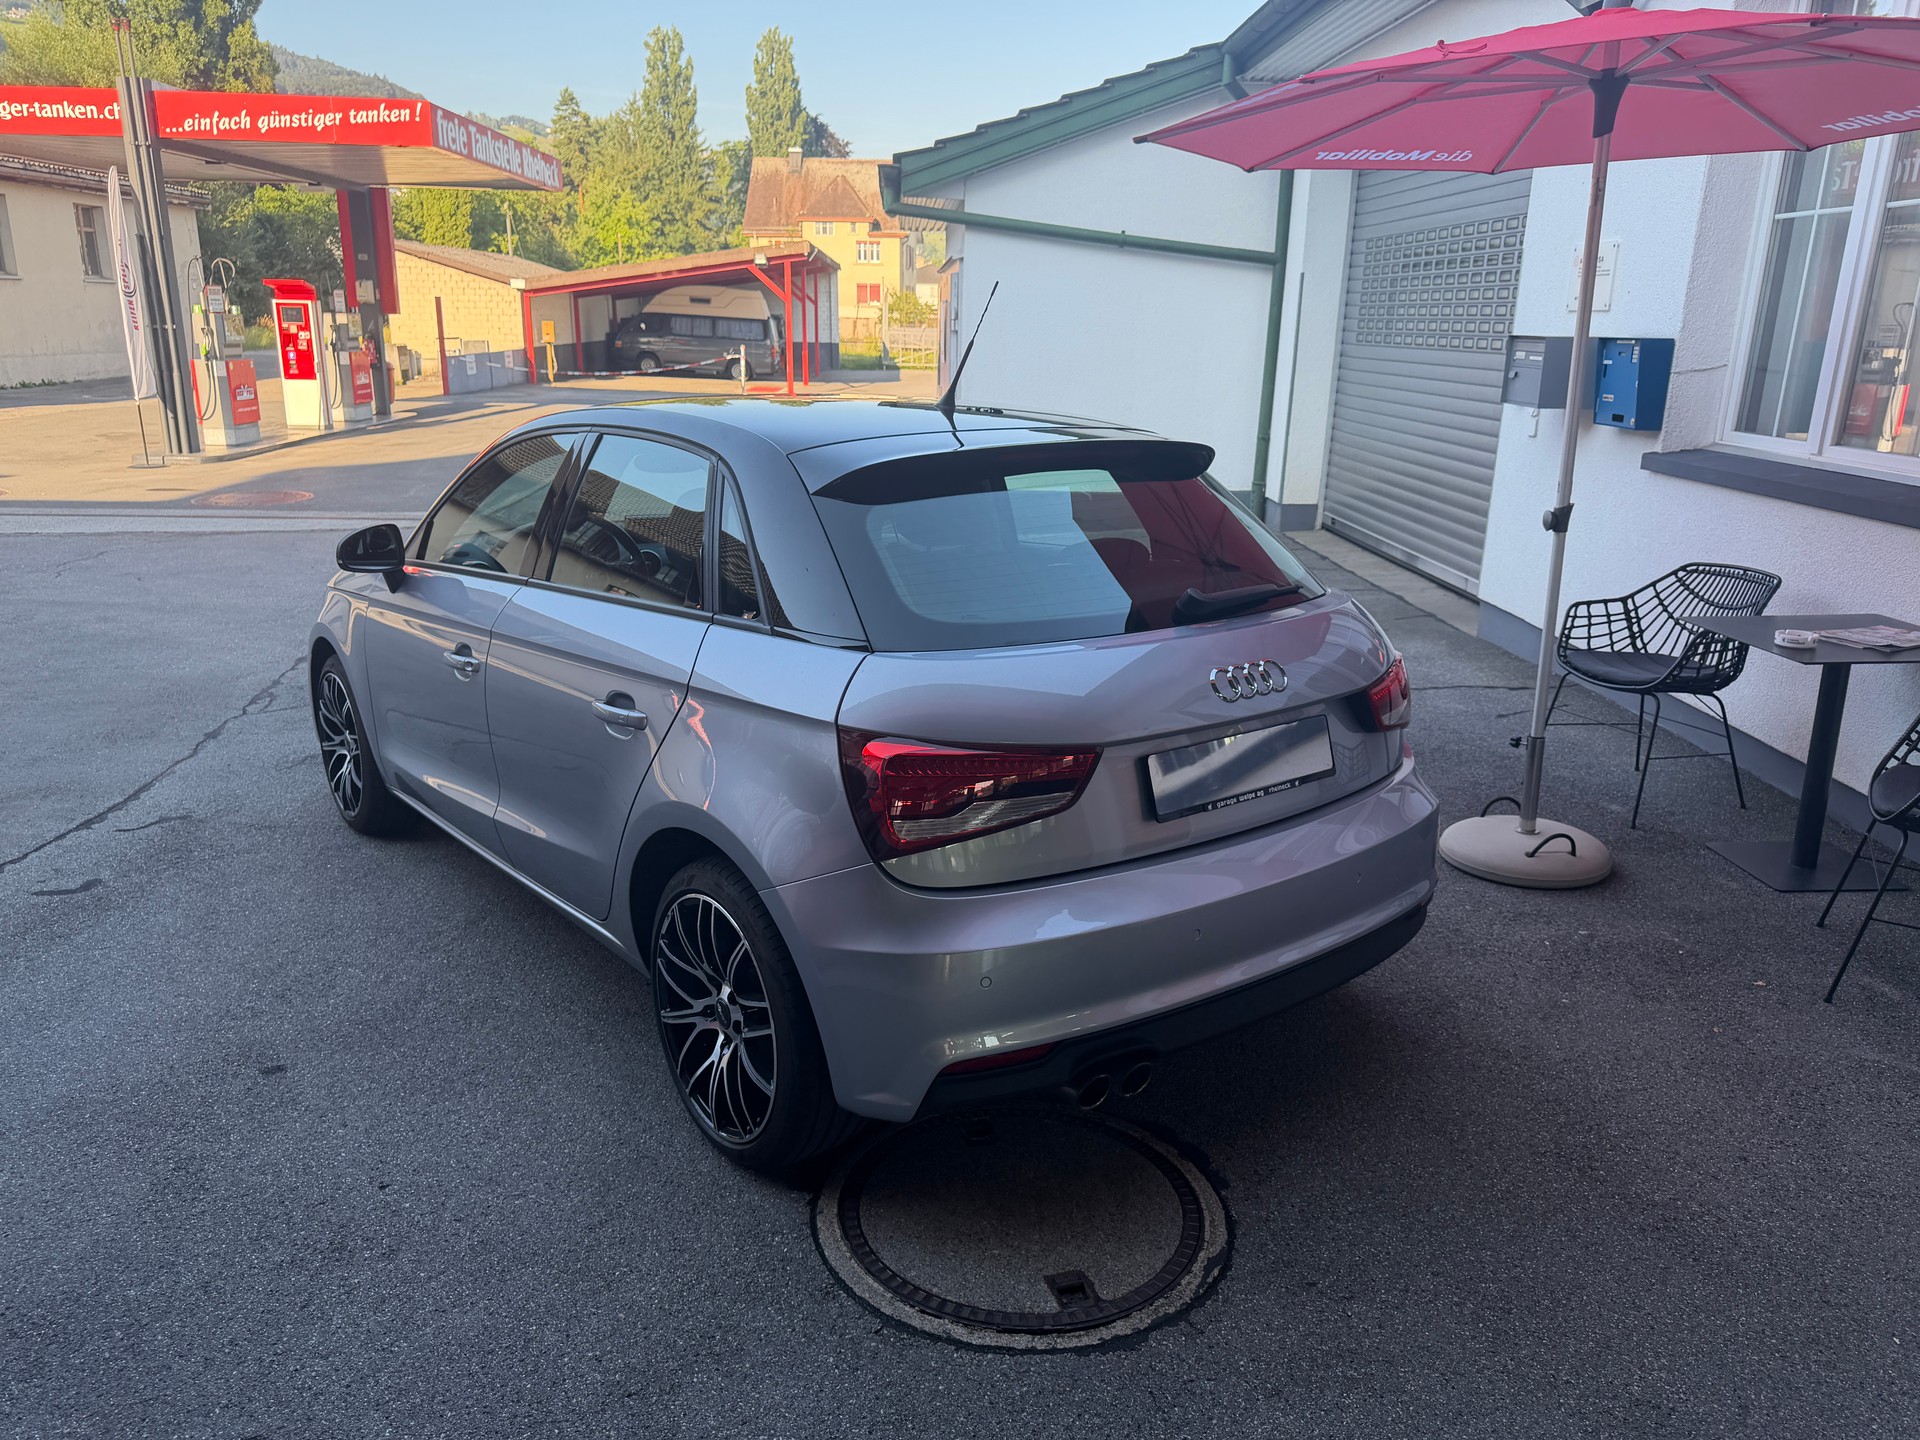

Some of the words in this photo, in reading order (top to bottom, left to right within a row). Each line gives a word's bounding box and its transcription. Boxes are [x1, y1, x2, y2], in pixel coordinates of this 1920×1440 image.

[257, 108, 343, 134] günstiger
[437, 109, 468, 155] freie
[468, 123, 522, 174] Tankstelle
[522, 146, 560, 188] Rheineck
[127, 300, 140, 331] REIFEN
[1216, 797, 1237, 809] garage
[1269, 782, 1291, 793] rheineck
